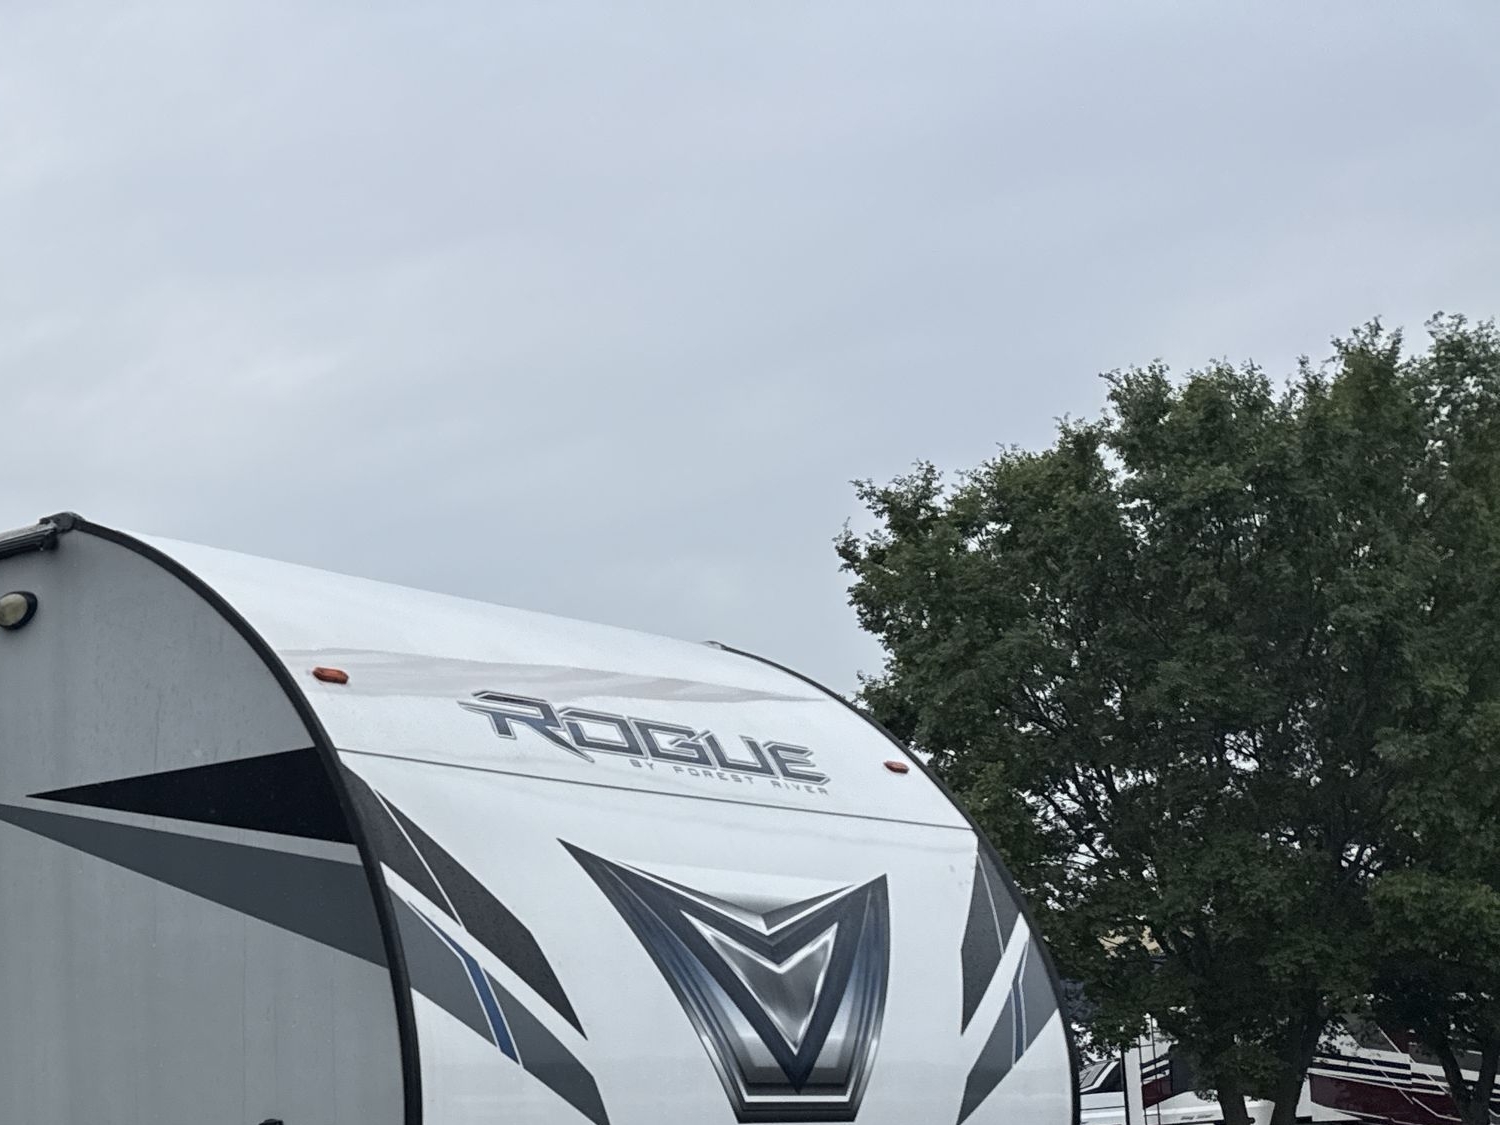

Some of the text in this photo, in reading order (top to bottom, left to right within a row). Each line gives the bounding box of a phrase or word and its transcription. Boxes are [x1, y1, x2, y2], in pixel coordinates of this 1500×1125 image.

[457, 690, 831, 786] ROGUE
[629, 759, 830, 796] BY FOREST RIVER
